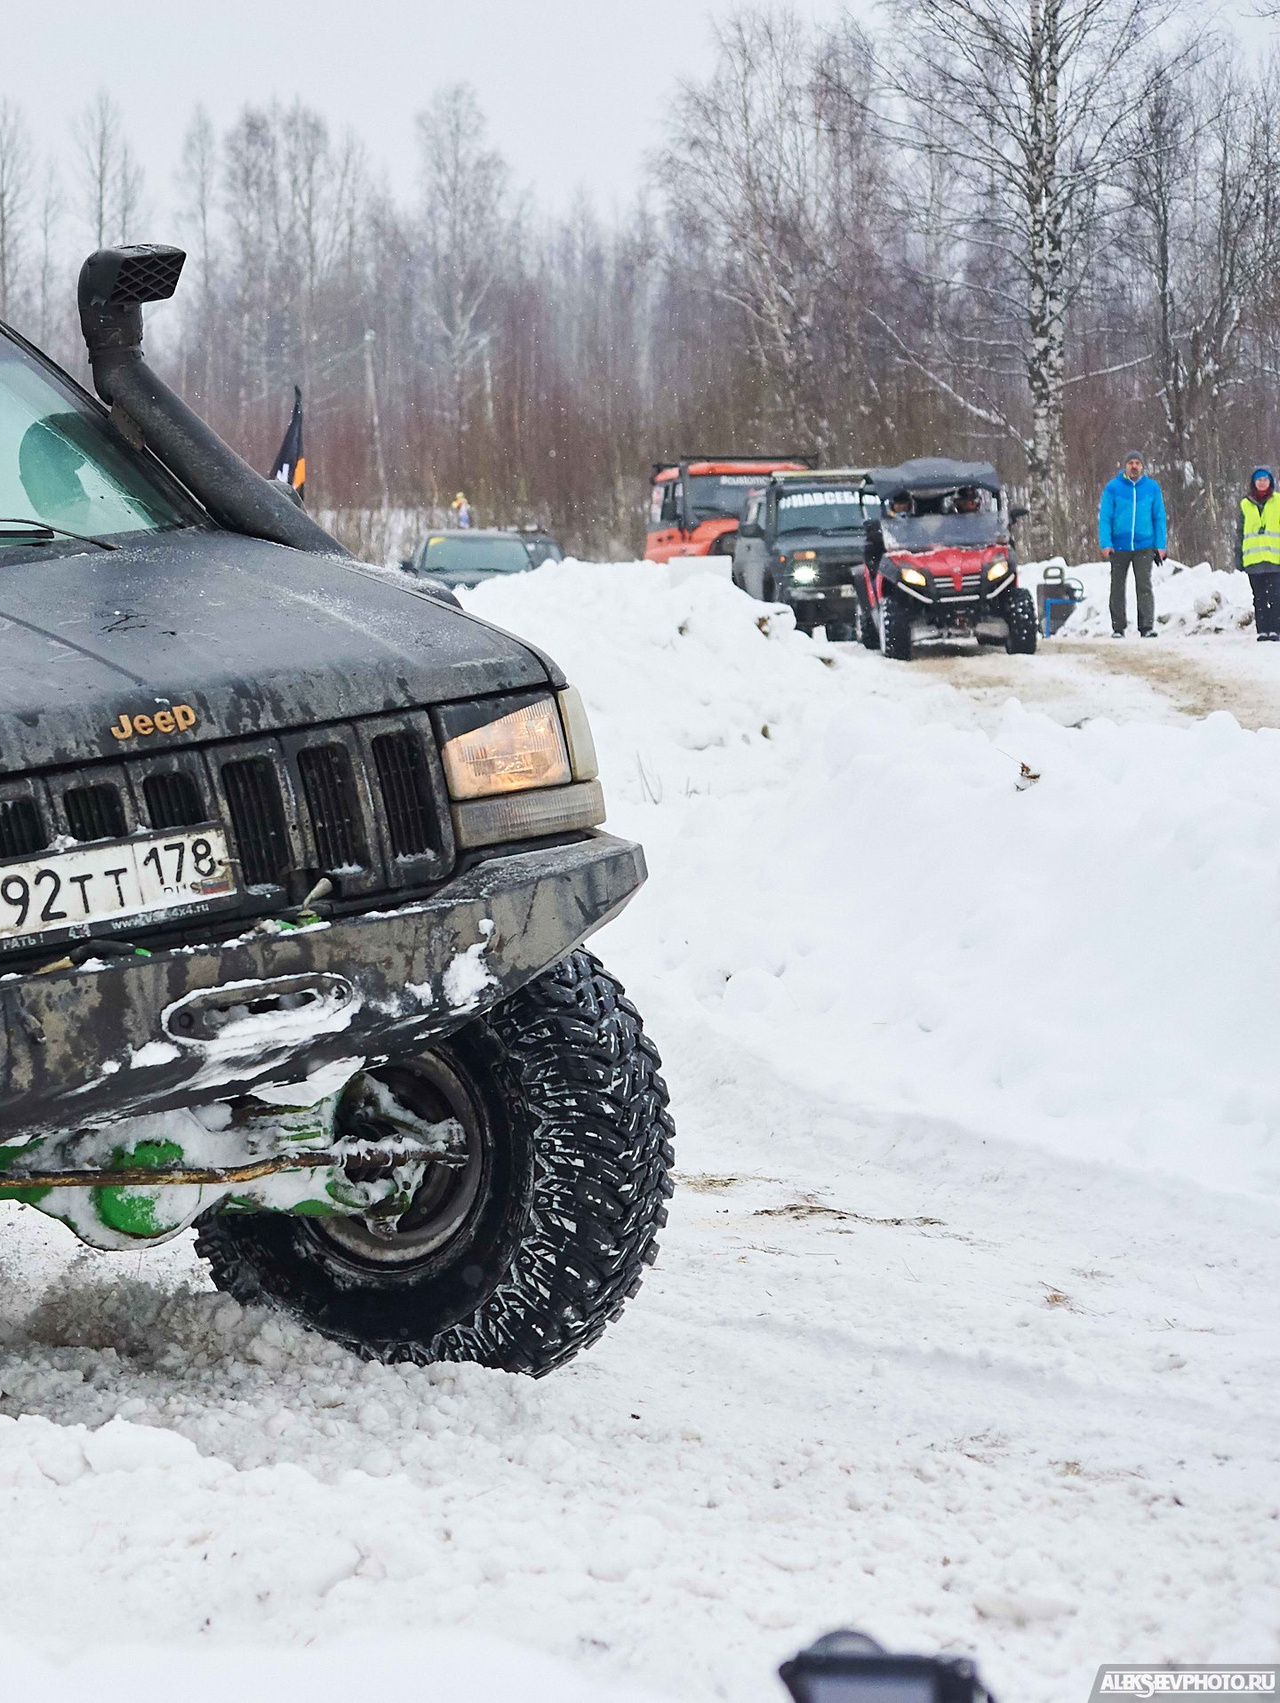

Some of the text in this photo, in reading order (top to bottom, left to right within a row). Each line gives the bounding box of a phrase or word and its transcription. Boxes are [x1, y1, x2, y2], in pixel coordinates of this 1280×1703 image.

[110, 703, 197, 740] Jeep
[142, 837, 216, 886] 178
[3, 935, 37, 950] РАТЬ
